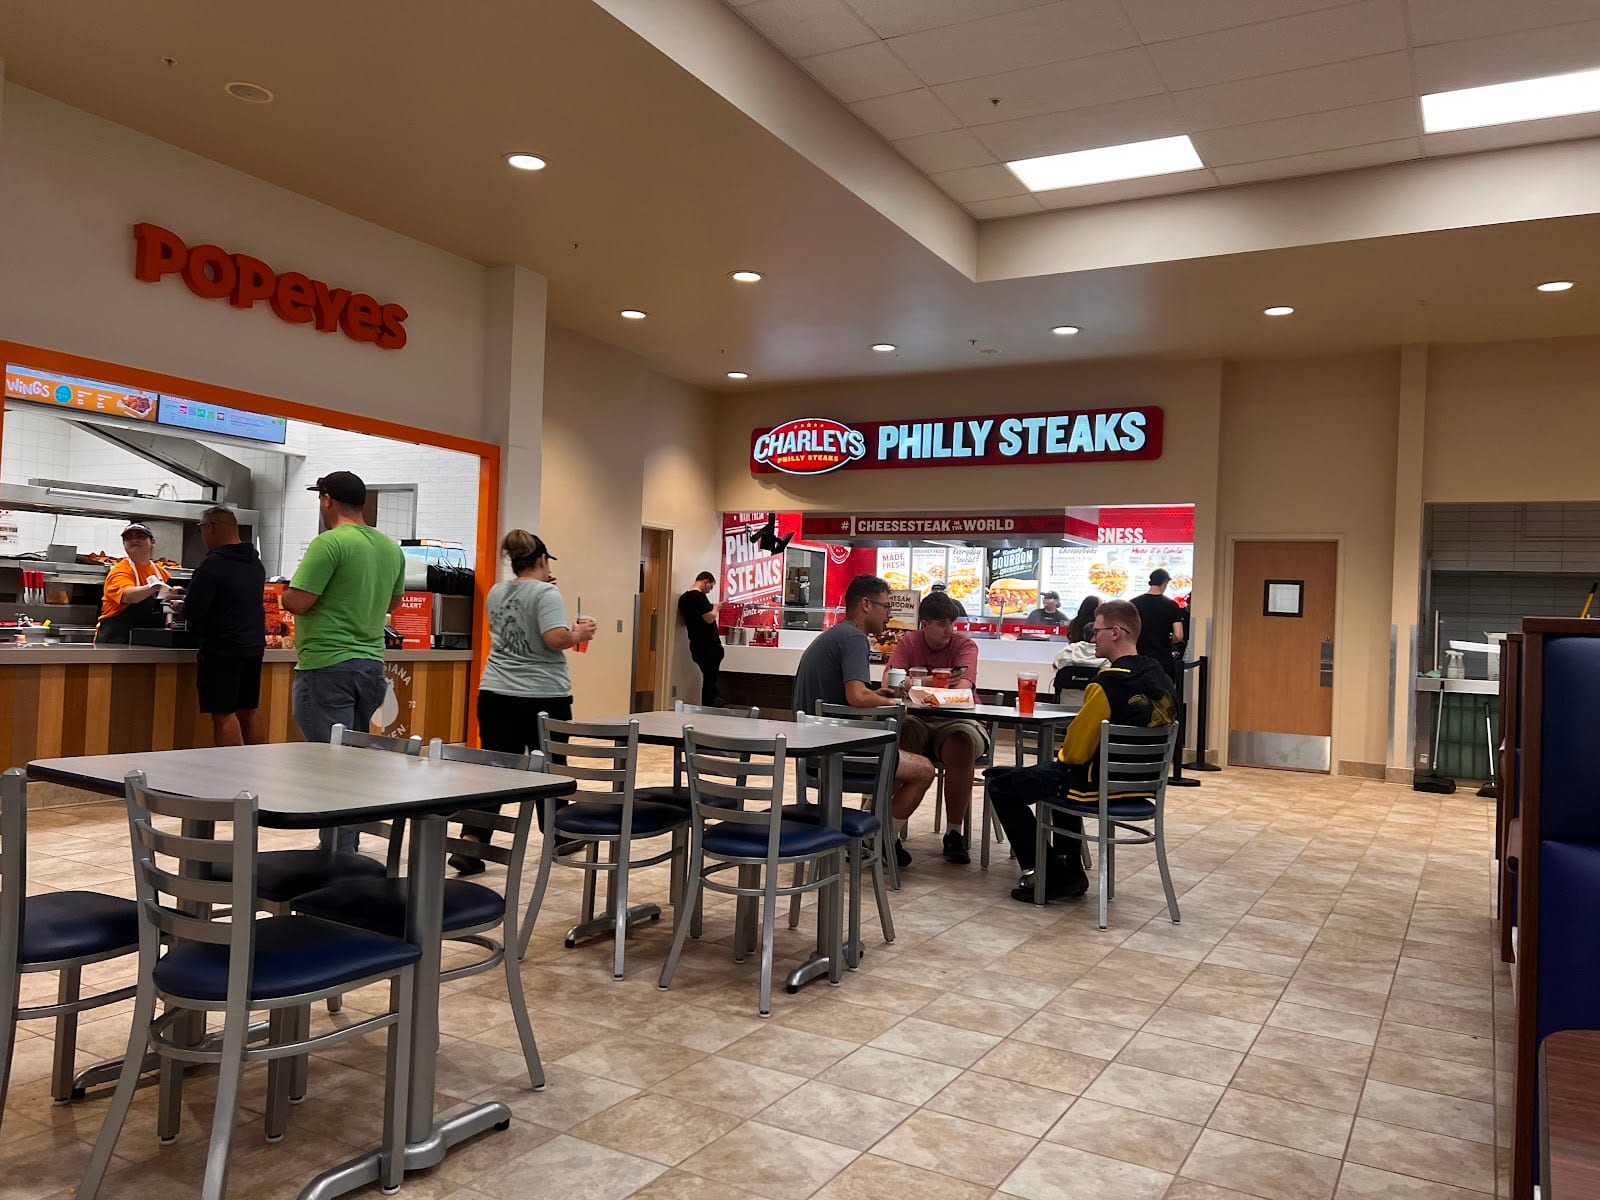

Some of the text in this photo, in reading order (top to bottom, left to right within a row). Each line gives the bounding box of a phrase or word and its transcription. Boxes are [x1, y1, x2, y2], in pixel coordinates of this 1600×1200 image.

[754, 429, 865, 460] CHARLEYS
[878, 411, 1147, 461] PHILLY STEAKS
[777, 454, 839, 463] PHILLY STEAKS
[858, 519, 951, 532] CHEESESTEAK
[963, 519, 1015, 531] WORLD
[725, 527, 779, 565] PHIL
[882, 552, 905, 561] MADE
[882, 561, 905, 569] FRESH
[992, 550, 1033, 571] BOURBON
[726, 559, 782, 596] STEAKS
[408, 700, 417, 709] 72
